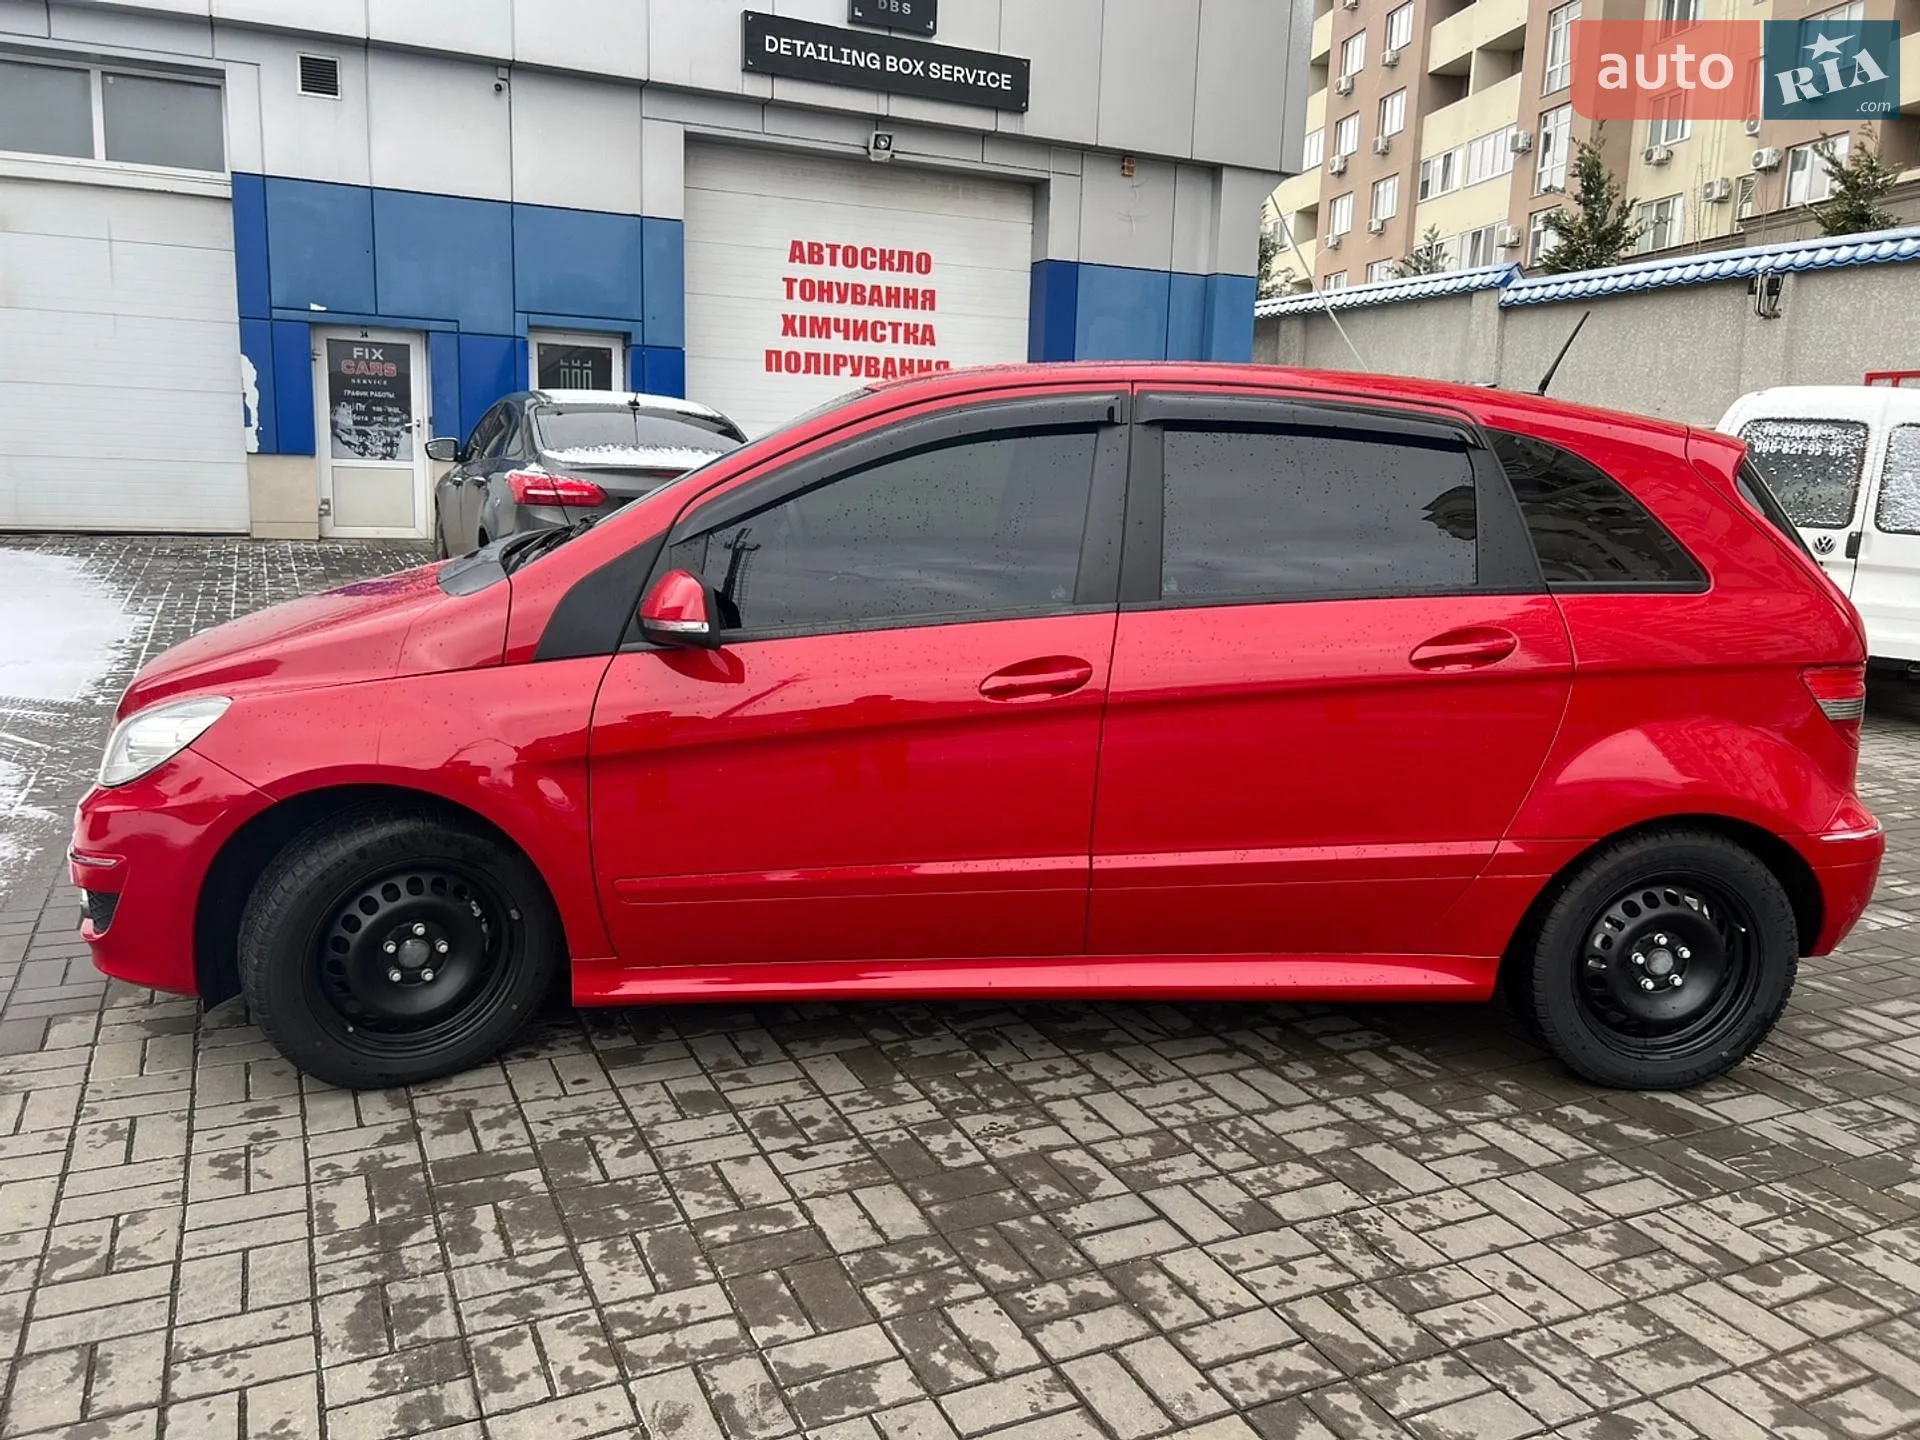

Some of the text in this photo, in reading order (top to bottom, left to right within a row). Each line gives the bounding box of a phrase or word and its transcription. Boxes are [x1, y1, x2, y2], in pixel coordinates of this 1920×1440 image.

[878, 0, 912, 15] DBS
[764, 35, 1012, 91] DETAILING BOX SERVICE
[788, 239, 932, 276] АВТОСКЛО
[782, 276, 936, 312] ТОНУВАННЯ
[781, 313, 936, 347] ХІМЧИСТКА
[341, 359, 397, 377] CARS
[353, 347, 384, 360] FIX
